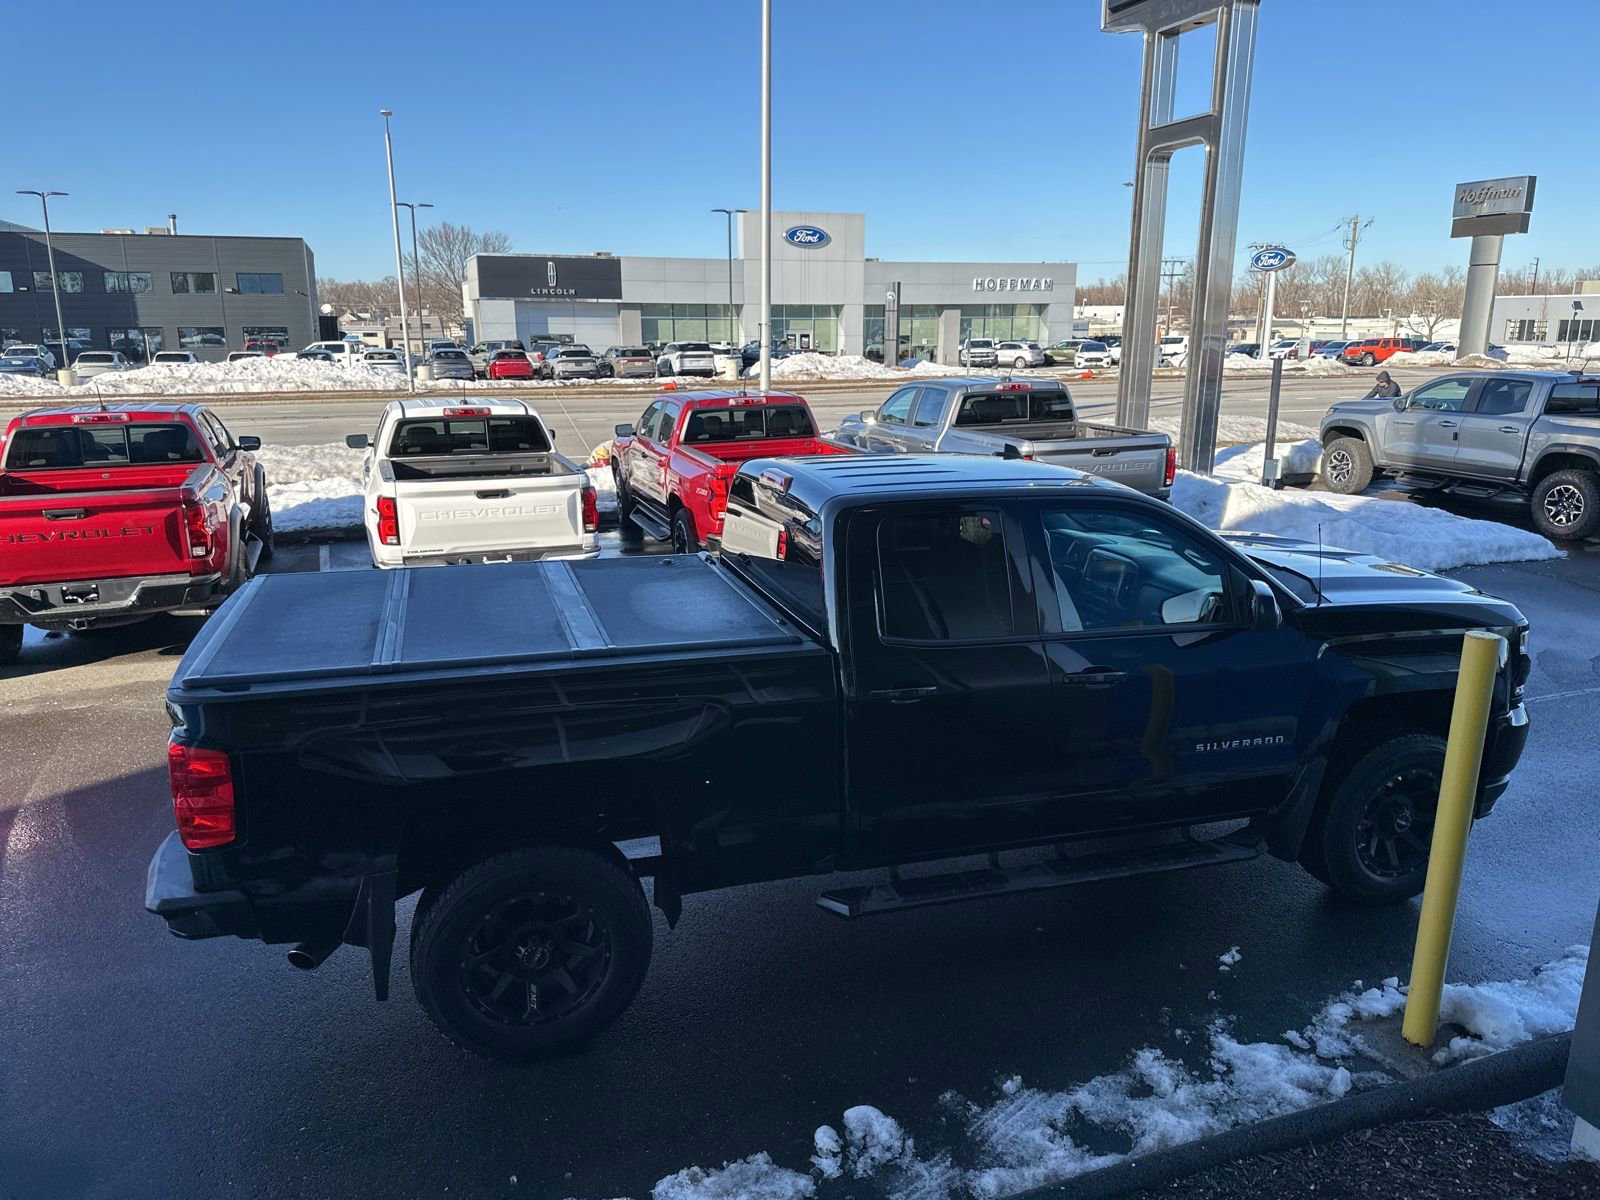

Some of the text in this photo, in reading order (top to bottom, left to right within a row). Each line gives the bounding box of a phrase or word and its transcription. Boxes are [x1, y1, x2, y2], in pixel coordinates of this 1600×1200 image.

[794, 230, 820, 243] Ford
[1258, 253, 1281, 267] Ford
[973, 278, 1054, 291] HOFFMAN
[1072, 462, 1156, 474] EVROLET
[418, 504, 563, 521] CHEVROLET
[0, 526, 158, 545] HEVROLET
[1195, 735, 1285, 752] SILVERADO
